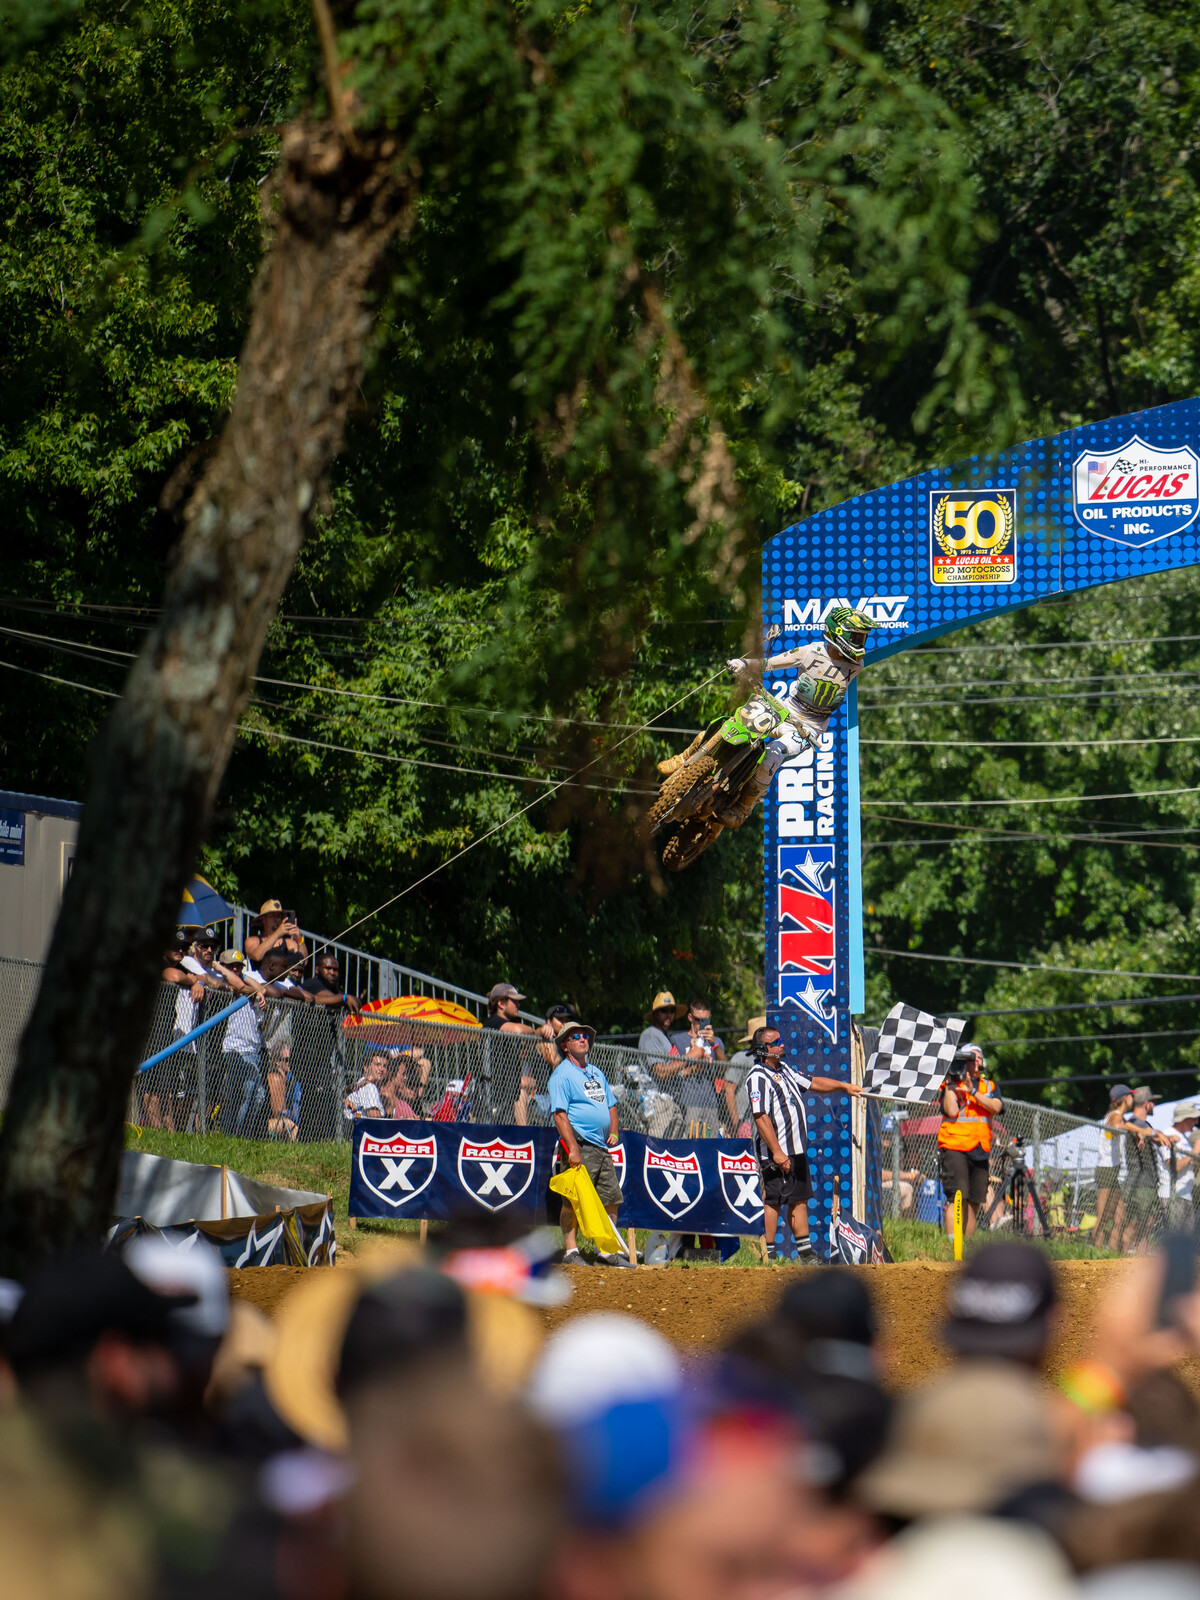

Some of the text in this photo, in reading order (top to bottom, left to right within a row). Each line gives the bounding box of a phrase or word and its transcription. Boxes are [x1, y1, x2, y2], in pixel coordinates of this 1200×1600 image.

[1139, 464, 1192, 472] PERFORMANCE
[1088, 473, 1190, 501] LUCAS
[1082, 504, 1193, 520] OIL PRODUCTS
[943, 500, 1006, 550] 50
[1123, 523, 1155, 535] INC.
[955, 556, 992, 565] LUCAS OIL
[946, 573, 1001, 581] CHAMPIONSHIP
[957, 565, 1011, 574] MOTOCROSS
[785, 623, 826, 632] MOTORS
[806, 659, 857, 682] FOX
[816, 732, 835, 836] RACING
[367, 1143, 431, 1154] RACER
[466, 1148, 529, 1159] RACER
[651, 1156, 695, 1171] RACER
[723, 1160, 758, 1171] RACE
[377, 1157, 416, 1191] X
[476, 1162, 514, 1196] X
[659, 1170, 692, 1204] X
[733, 1174, 765, 1207] X
